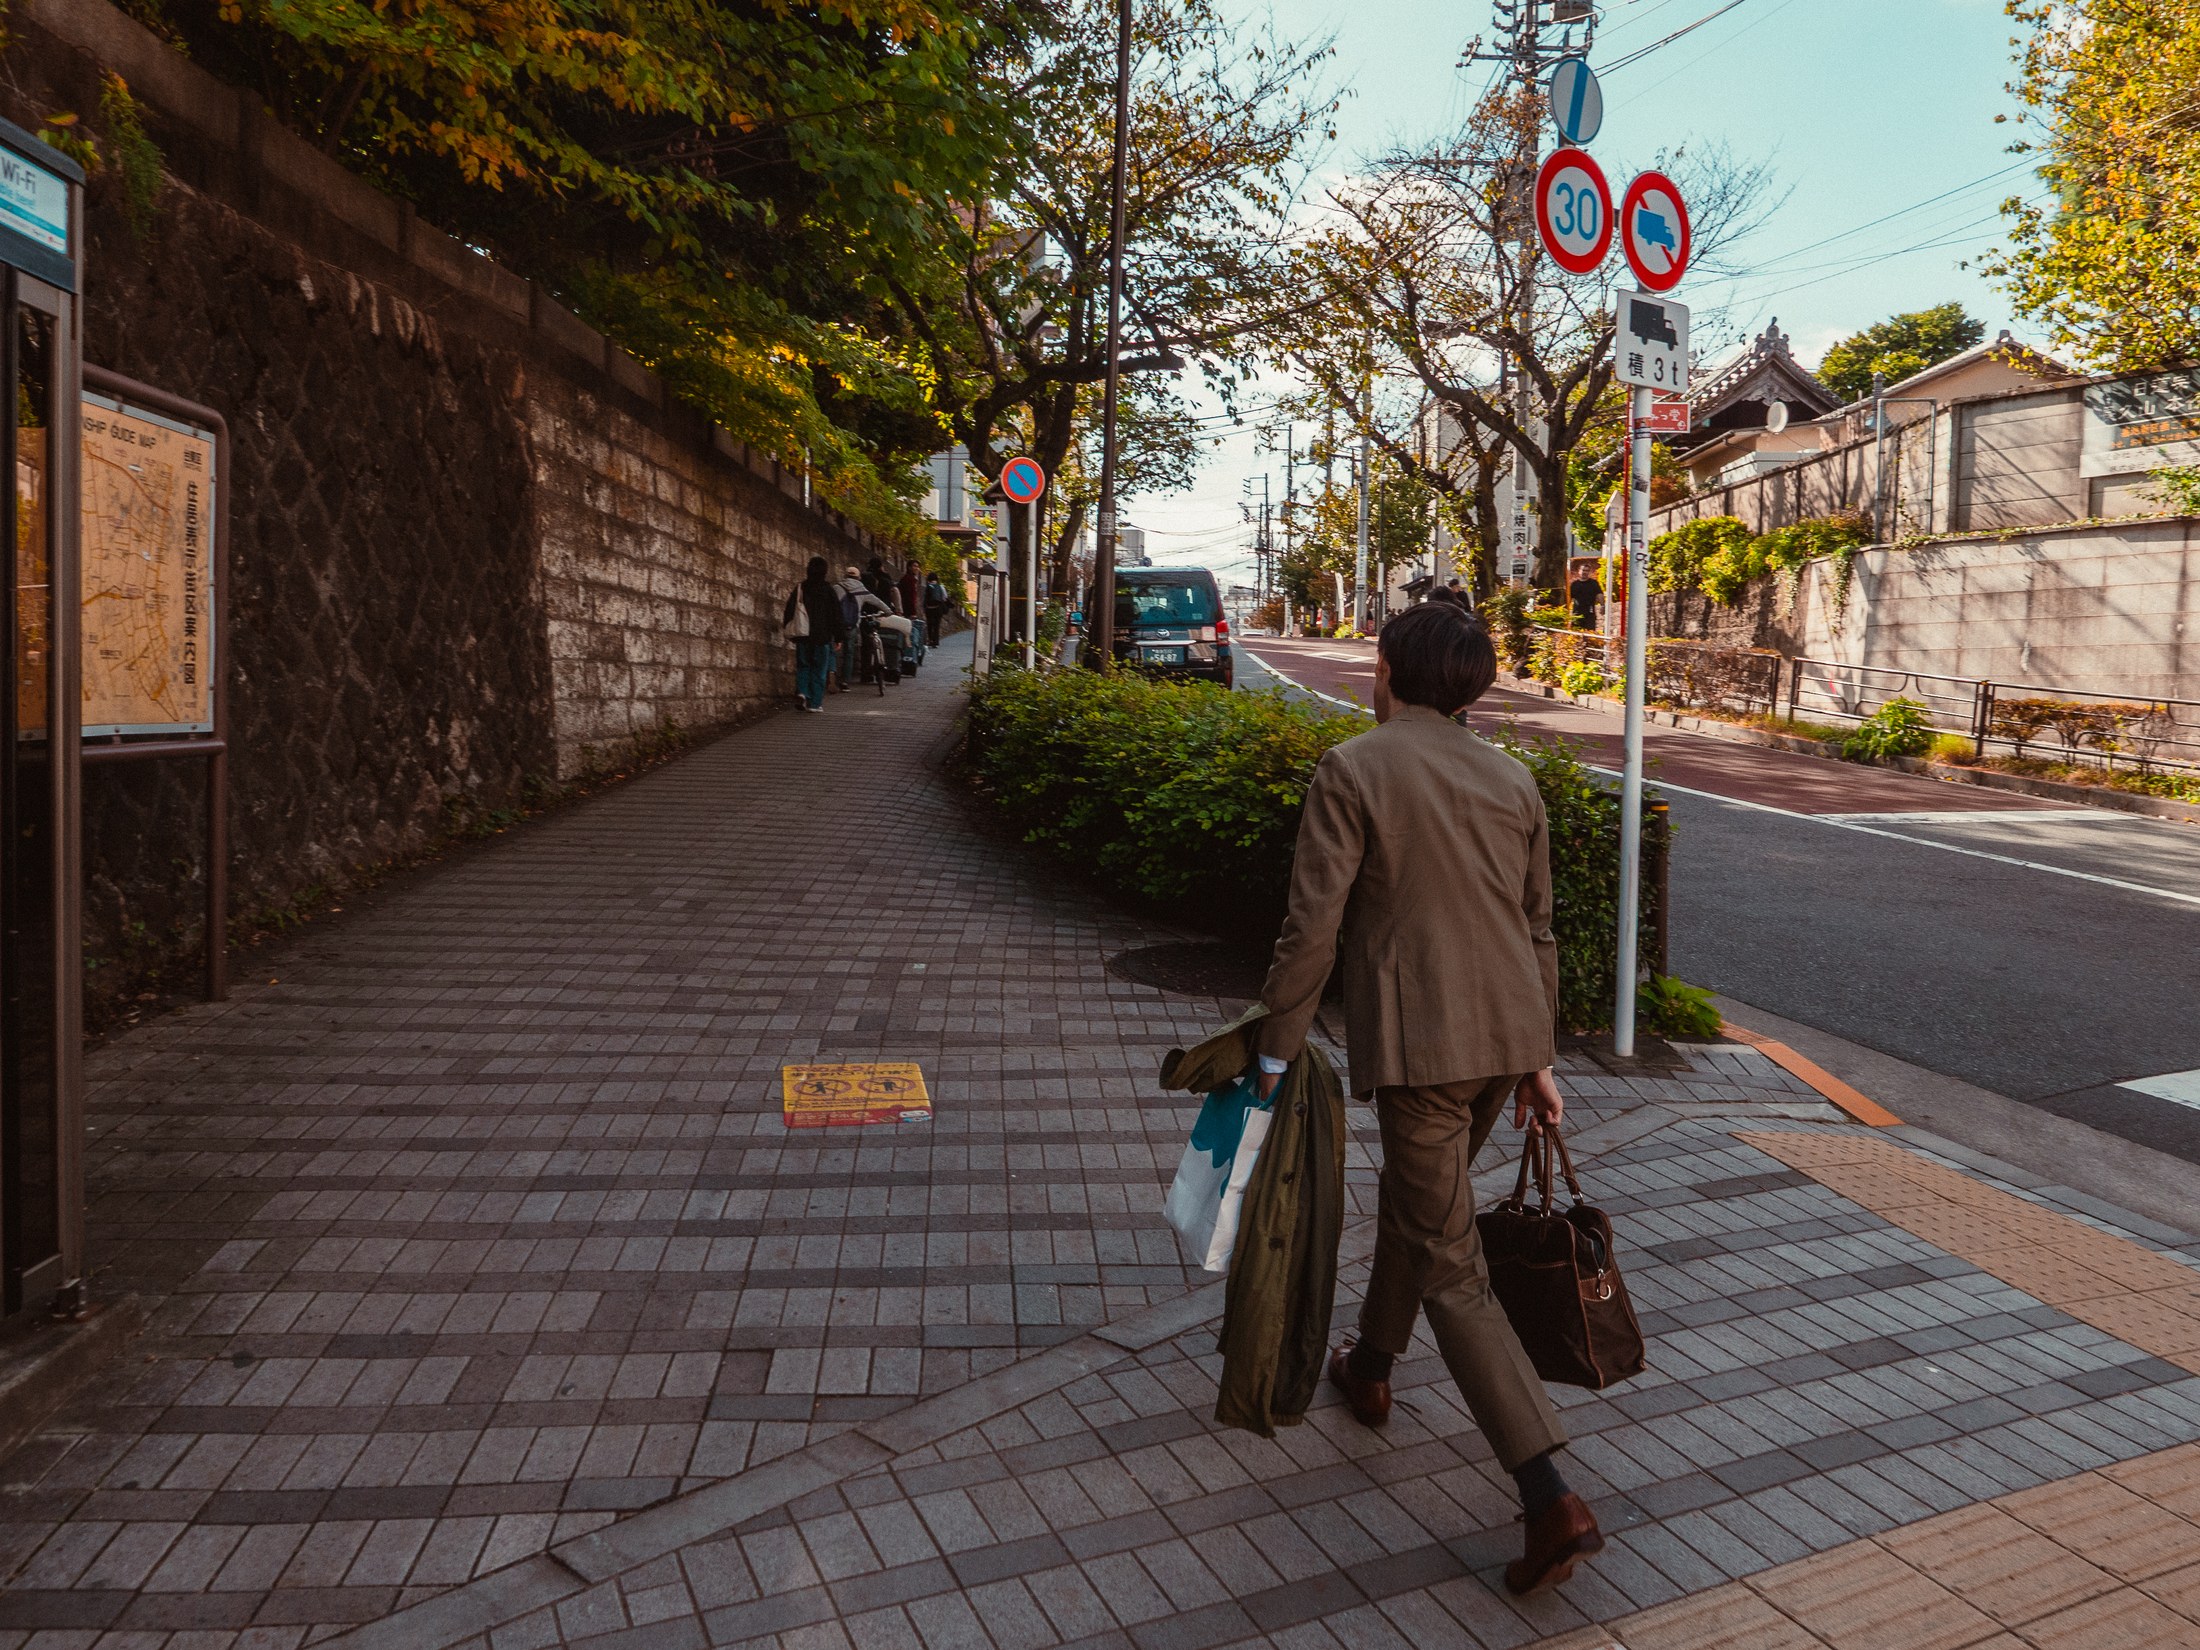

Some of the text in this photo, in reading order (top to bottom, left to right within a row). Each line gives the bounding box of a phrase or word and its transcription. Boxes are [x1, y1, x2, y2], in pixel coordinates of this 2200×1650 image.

[2, 156, 36, 194] Wi-Fi
[1555, 182, 1597, 241] 30
[110, 424, 136, 444] GUIDE
[139, 433, 156, 449] MAP
